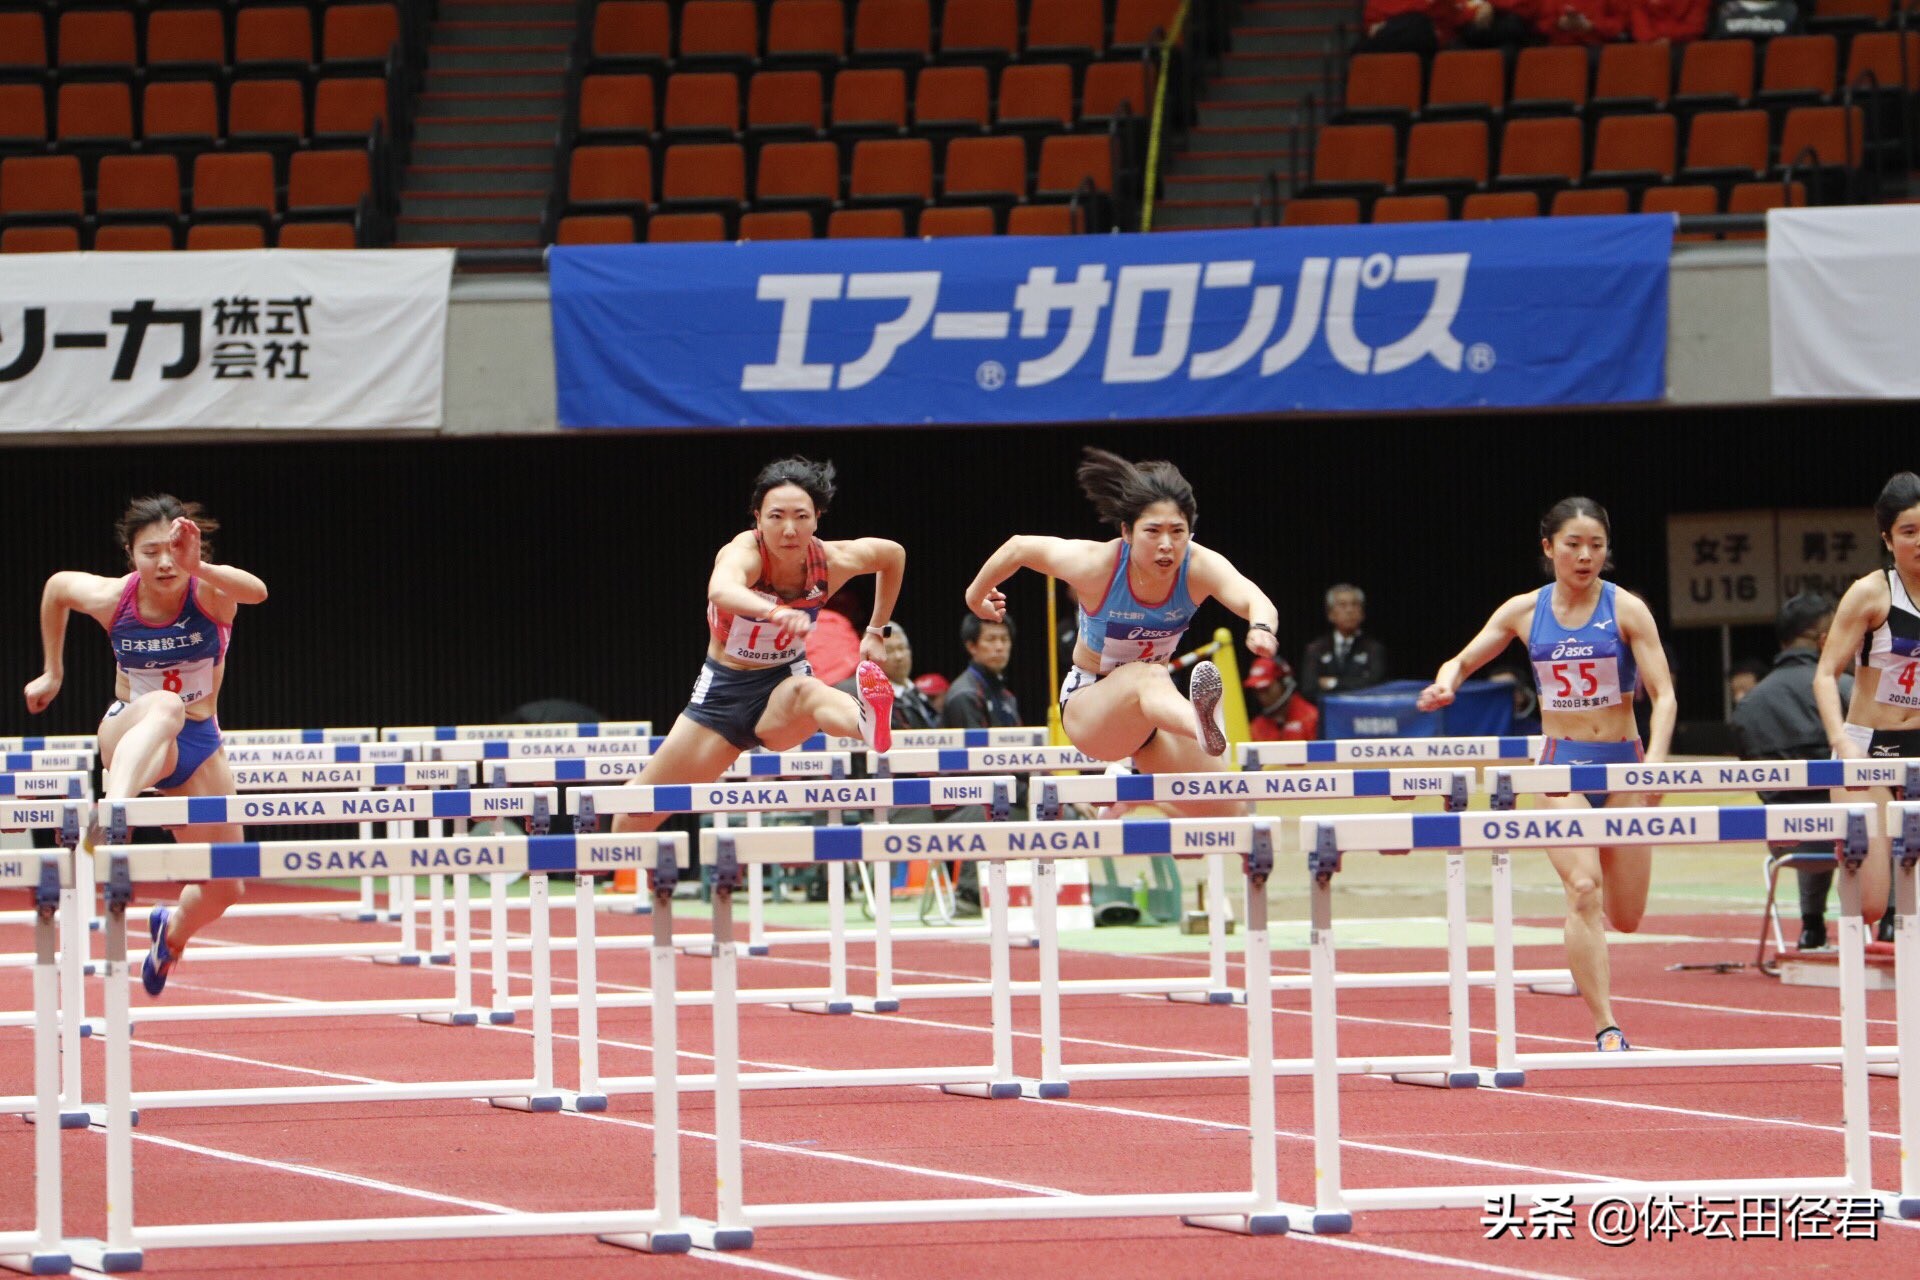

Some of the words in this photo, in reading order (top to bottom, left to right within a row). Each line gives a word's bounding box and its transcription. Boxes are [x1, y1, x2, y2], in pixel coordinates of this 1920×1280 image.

[211, 295, 313, 335] 株式
[211, 341, 310, 379] 会社
[1693, 534, 1750, 565] 女子
[1802, 531, 1857, 563] 男子
[1690, 575, 1757, 602] U16
[121, 631, 204, 652] 日本建設工業
[737, 647, 797, 661] 2020日本室内
[1551, 662, 1598, 698] 55
[1897, 661, 1919, 695] 4
[1552, 696, 1609, 709] 2020日本室内
[1888, 693, 1920, 706] 2020日
[903, 735, 953, 746] NAGAI
[228, 751, 261, 762] AKA
[272, 750, 323, 761] NAGAI
[521, 743, 576, 755] OSAKA
[587, 743, 637, 754] NAGAI
[1350, 745, 1414, 758] OSAKA
[1427, 744, 1485, 756] NAGAI
[791, 760, 823, 771] NISHI
[982, 753, 1046, 766] OSAKA
[232, 771, 288, 784] SAKA
[302, 769, 361, 783] NAGAI
[416, 769, 449, 780] NISHI
[597, 760, 649, 777] OSAK
[1625, 769, 1703, 786] OSAKA
[1719, 767, 1790, 784] NAGAI
[1857, 768, 1896, 781] NISHI
[24, 779, 58, 790] NISHI
[1171, 779, 1250, 796] OSAKA
[1265, 777, 1336, 794] NAGAI
[1403, 777, 1442, 791] NISHI
[709, 789, 789, 805] OSAKA
[805, 787, 876, 803] NAGAI
[943, 786, 982, 799] NISHI
[244, 800, 326, 818] OSAKA
[342, 797, 415, 815] NAGAI
[484, 797, 524, 811] NISHI
[13, 810, 54, 823] NISHI
[1483, 819, 1584, 840] OSAKA
[1605, 817, 1696, 837] NAGAI
[1784, 817, 1834, 833] NISHI
[884, 833, 987, 854] OSAKA
[1008, 831, 1100, 851] NAGAI
[1185, 831, 1235, 847] NISHI
[283, 850, 388, 871] OSAKA
[410, 846, 504, 867] NAGAI
[591, 846, 642, 862] NISHI
